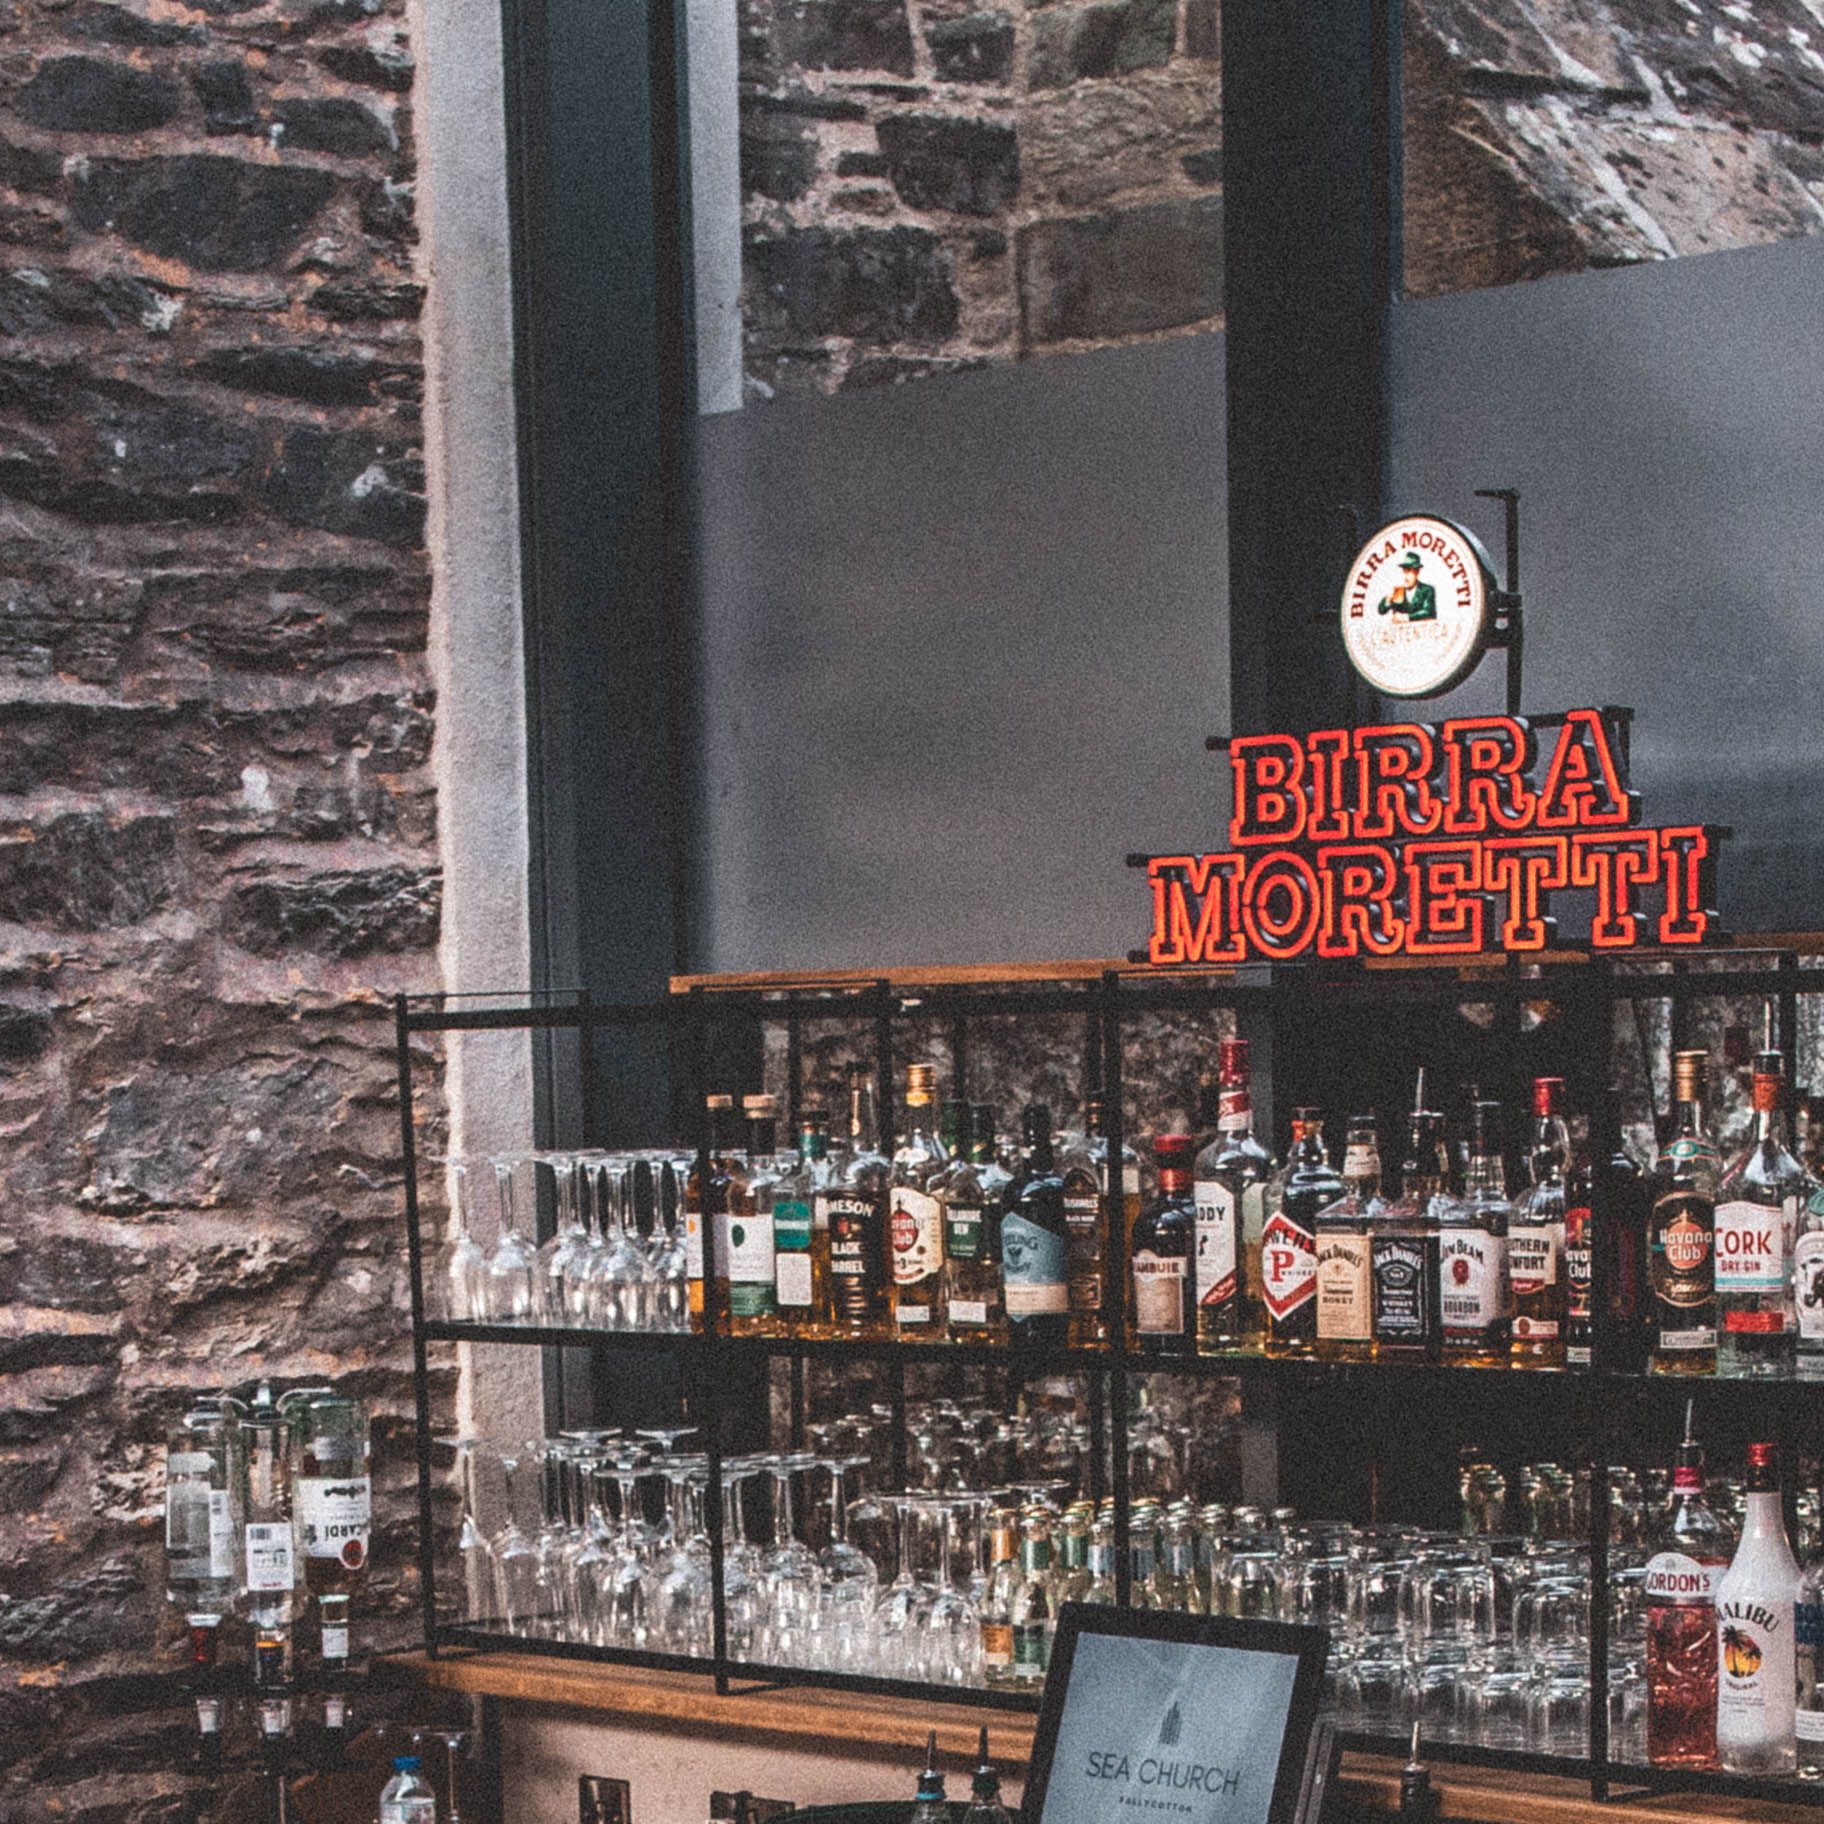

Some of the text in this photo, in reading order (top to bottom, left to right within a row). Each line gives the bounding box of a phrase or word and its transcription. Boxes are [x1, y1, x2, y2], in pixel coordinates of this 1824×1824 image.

[1350, 531, 1472, 619] BIRRA MORETTI
[1229, 709, 1630, 846] BIRRA
[1148, 825, 1708, 964] MORETTI
[1669, 1245, 1702, 1261] Club
[1715, 1227, 1773, 1258] CORK
[1085, 1751, 1242, 1796] SEA CHURCH
